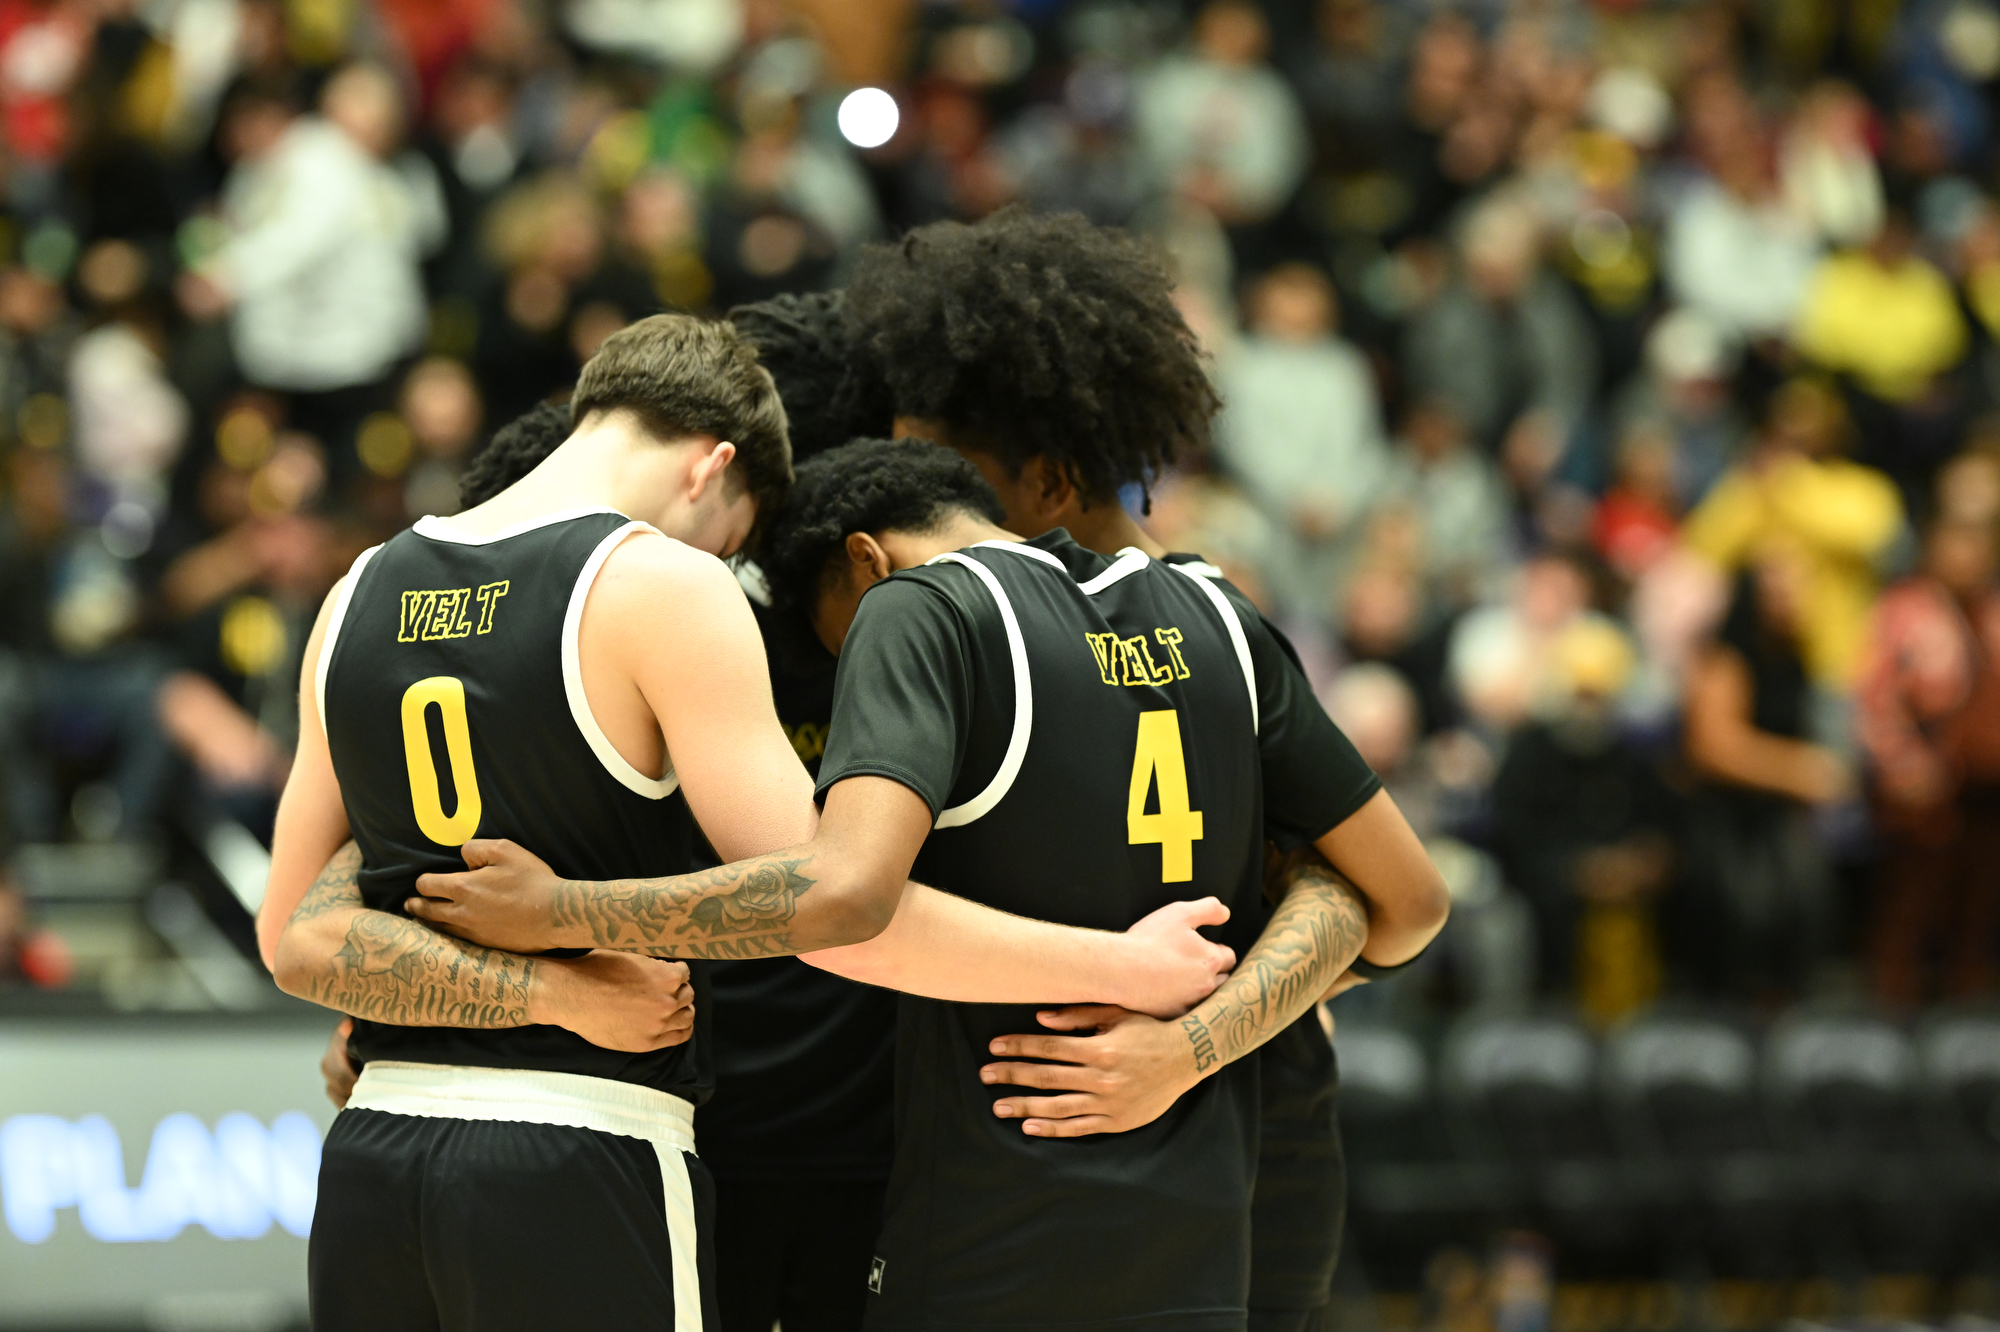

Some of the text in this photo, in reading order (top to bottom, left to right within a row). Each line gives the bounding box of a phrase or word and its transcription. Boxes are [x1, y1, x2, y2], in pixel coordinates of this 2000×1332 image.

[398, 580, 509, 642] VELT
[1085, 627, 1191, 686] VELT
[401, 676, 482, 846] 0
[1127, 709, 1203, 883] 4
[491, 968, 512, 1004] beauty
[1181, 1014, 1218, 1074] 2005
